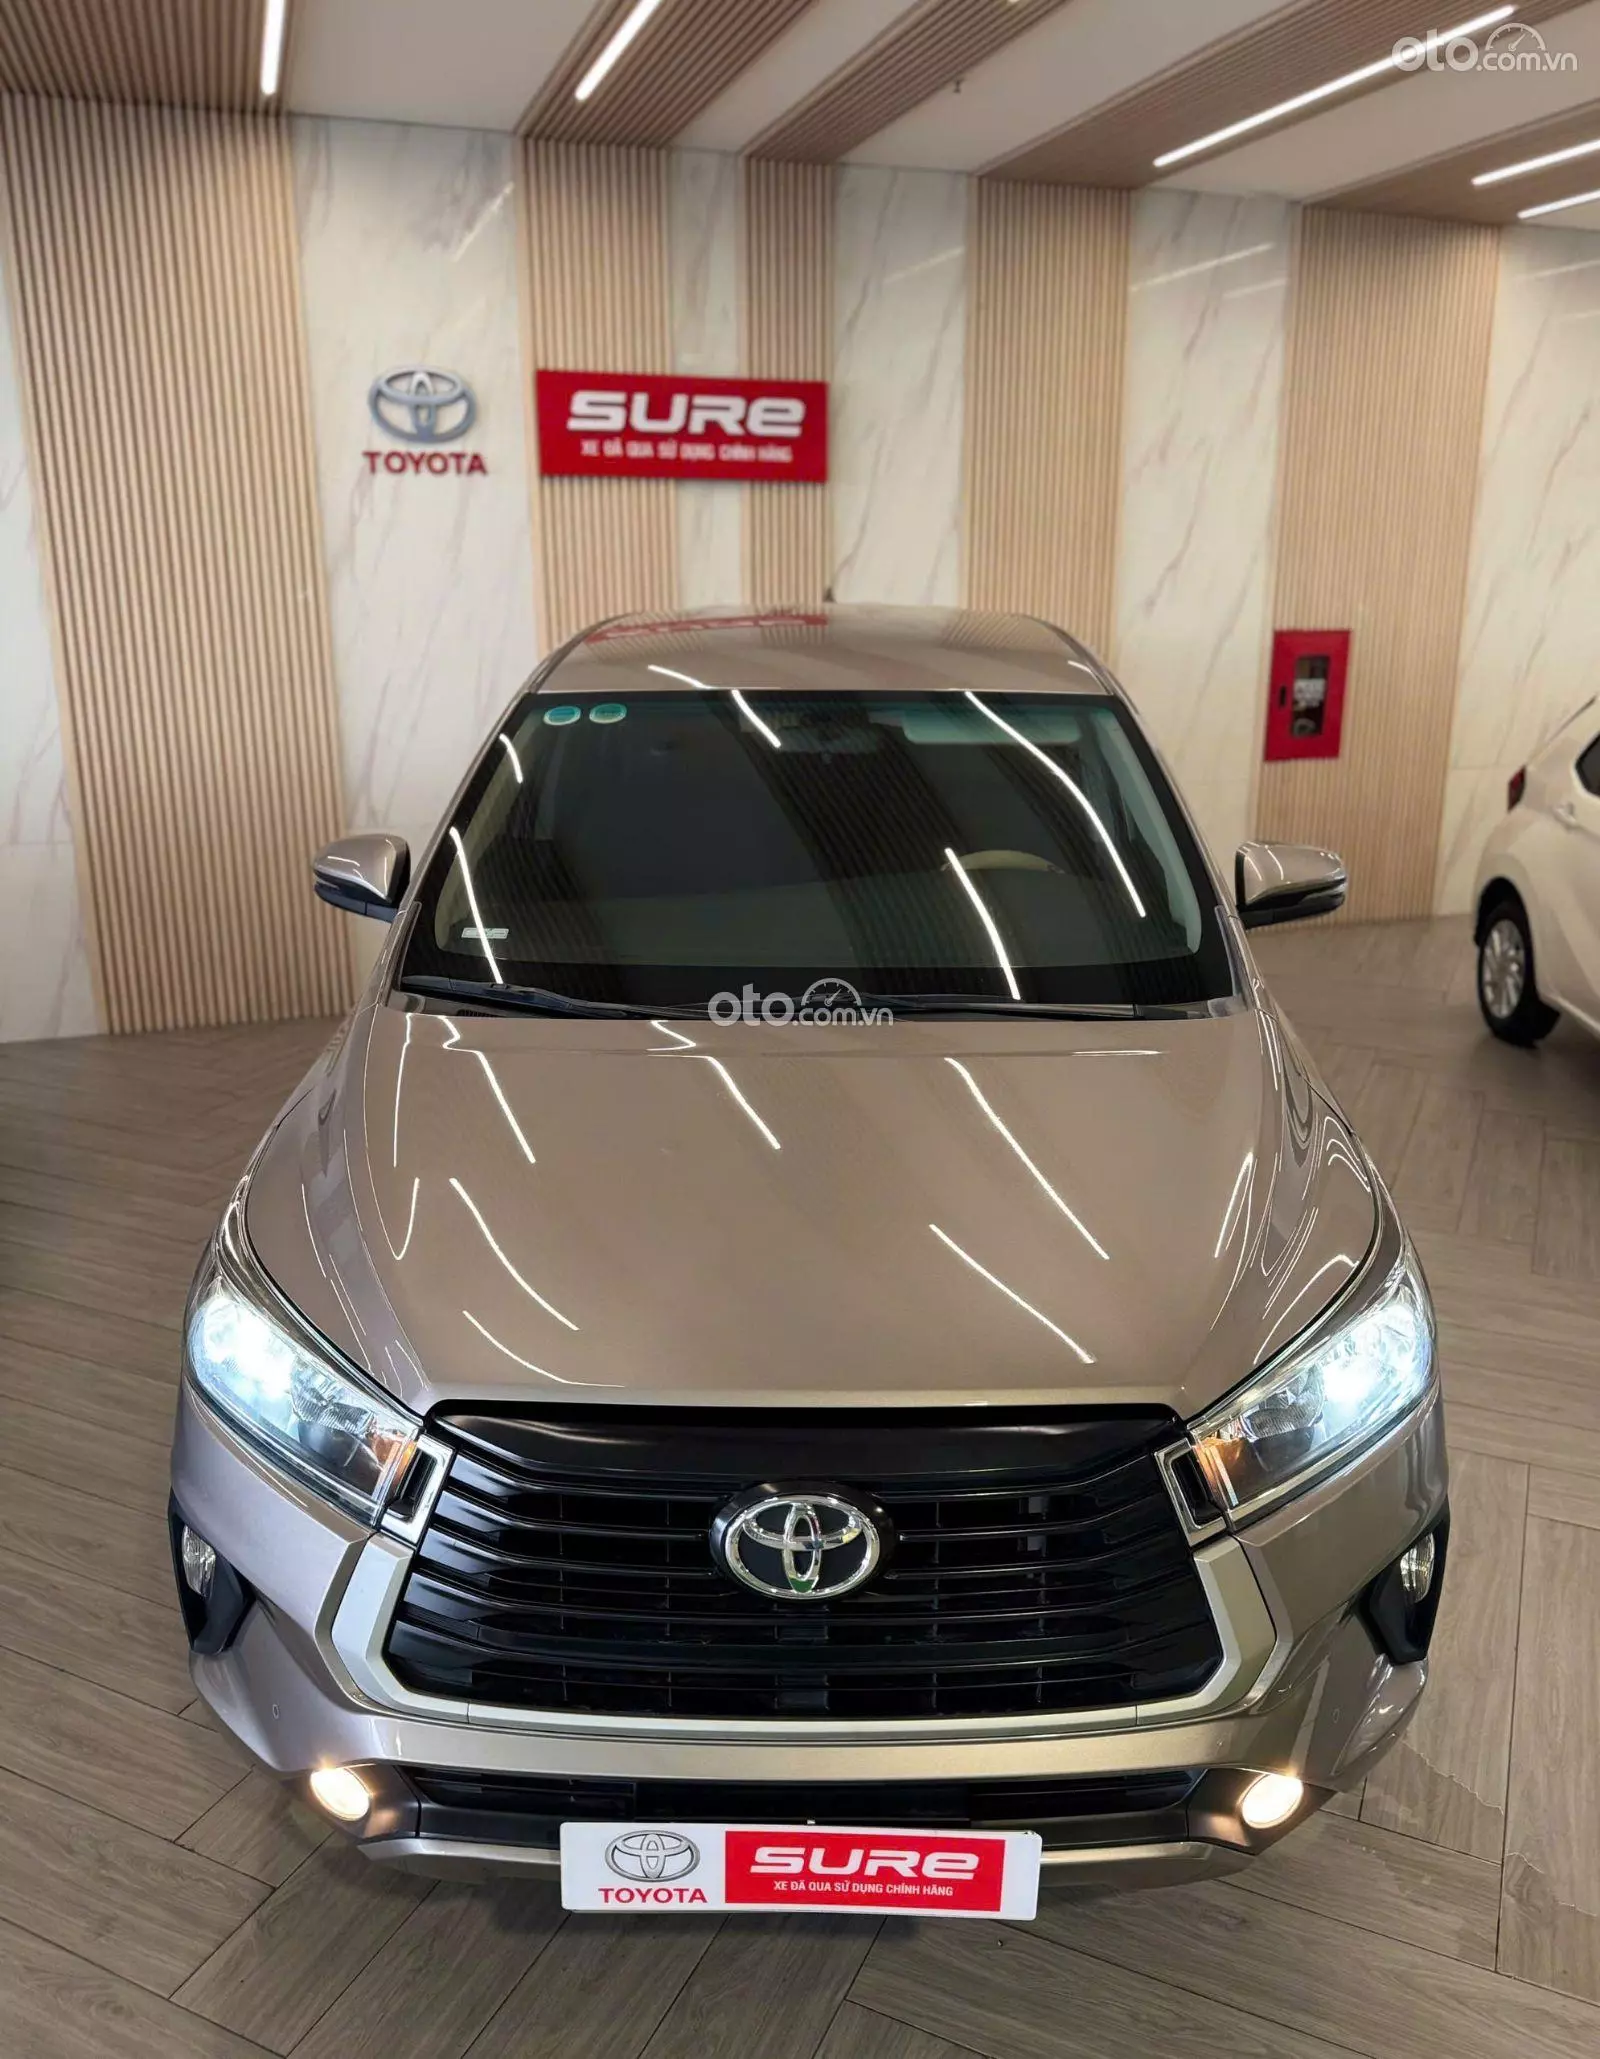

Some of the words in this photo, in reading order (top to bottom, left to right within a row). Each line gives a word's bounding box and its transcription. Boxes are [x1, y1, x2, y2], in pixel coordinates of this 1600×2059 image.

[363, 452, 487, 475] TOYOTA
[598, 1888, 708, 1904] TOYOTA
[774, 1881, 788, 1890] XE
[790, 1879, 806, 1891] ĐÃ
[808, 1881, 832, 1892] QUA
[834, 1880, 850, 1892] SỬ
[851, 1882, 883, 1895] DỤNG
[886, 1883, 920, 1895] CHÍNH
[922, 1884, 953, 1896] HÃNG
